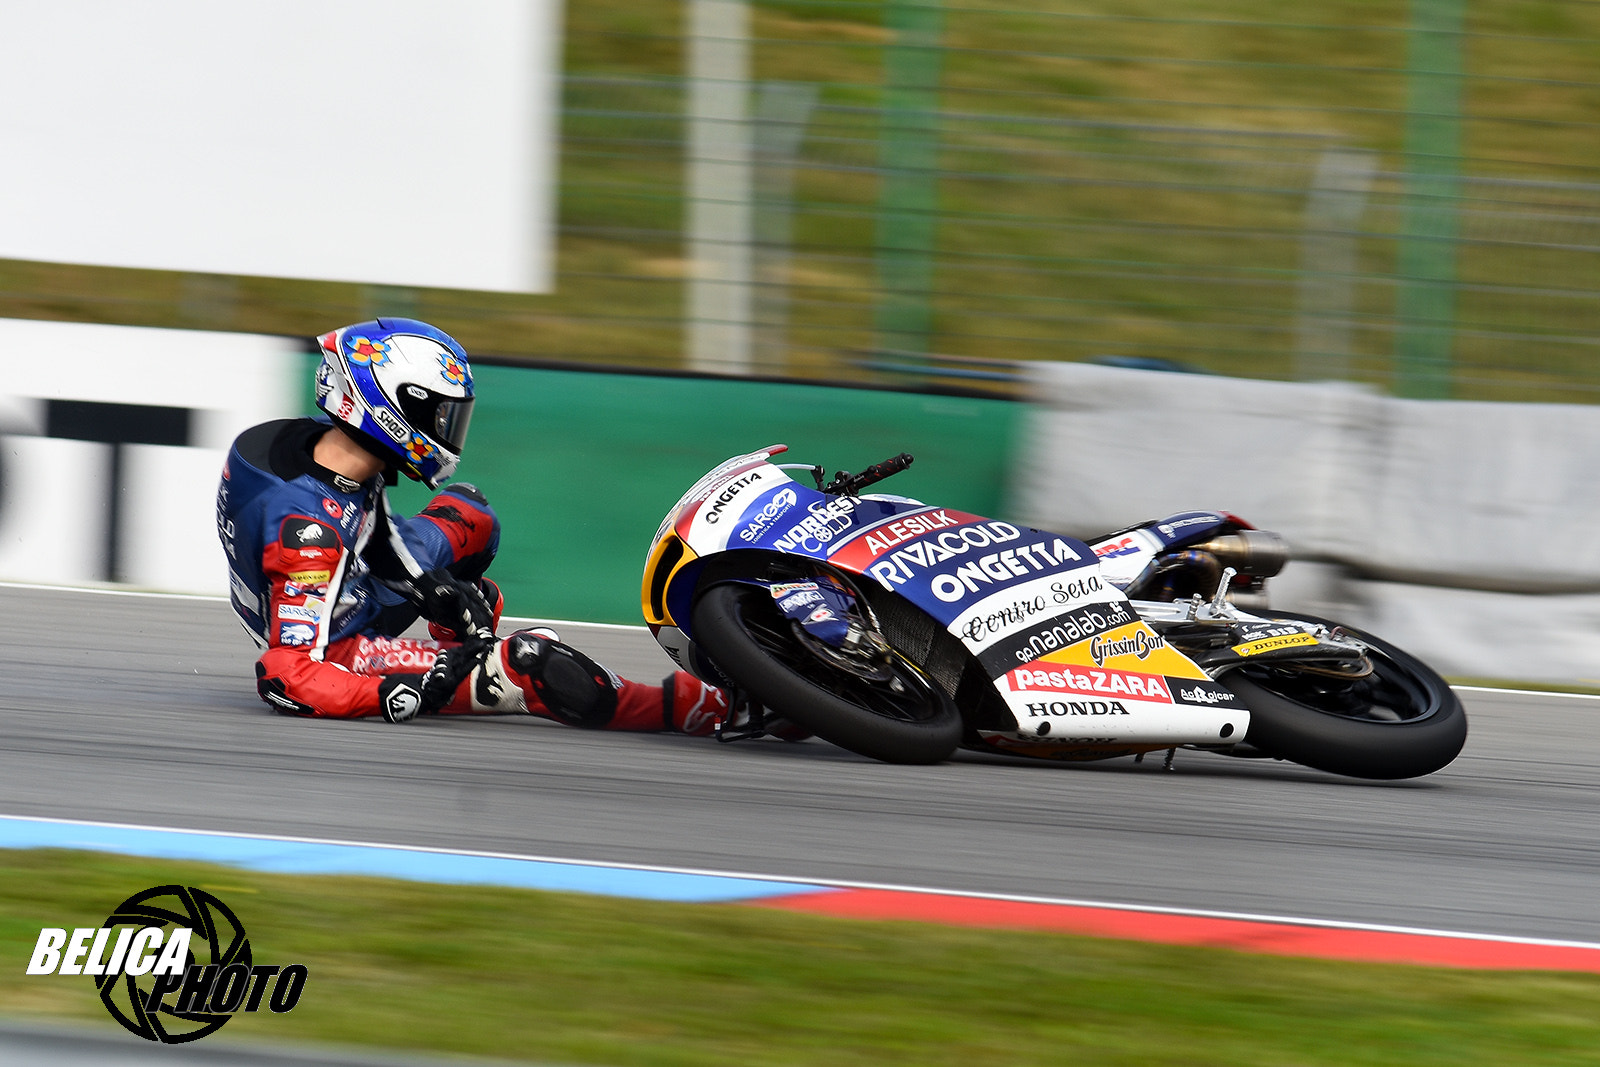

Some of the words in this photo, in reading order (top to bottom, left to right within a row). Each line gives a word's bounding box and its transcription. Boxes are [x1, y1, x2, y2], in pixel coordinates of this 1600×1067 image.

[377, 410, 407, 439] SHOEI
[705, 472, 762, 525] ONGETTA
[739, 487, 797, 543] SARGO
[864, 509, 959, 556] ALESILK
[870, 520, 1022, 593] RIVACOLD
[930, 538, 1082, 602] ONGETTA
[1050, 574, 1104, 604] Seta
[279, 605, 317, 618] SARGO
[1090, 630, 1165, 668] GrissinBon
[1253, 637, 1310, 651] DUNLOP
[1014, 668, 1169, 699] pastaZARA
[1027, 701, 1130, 718] HONDA
